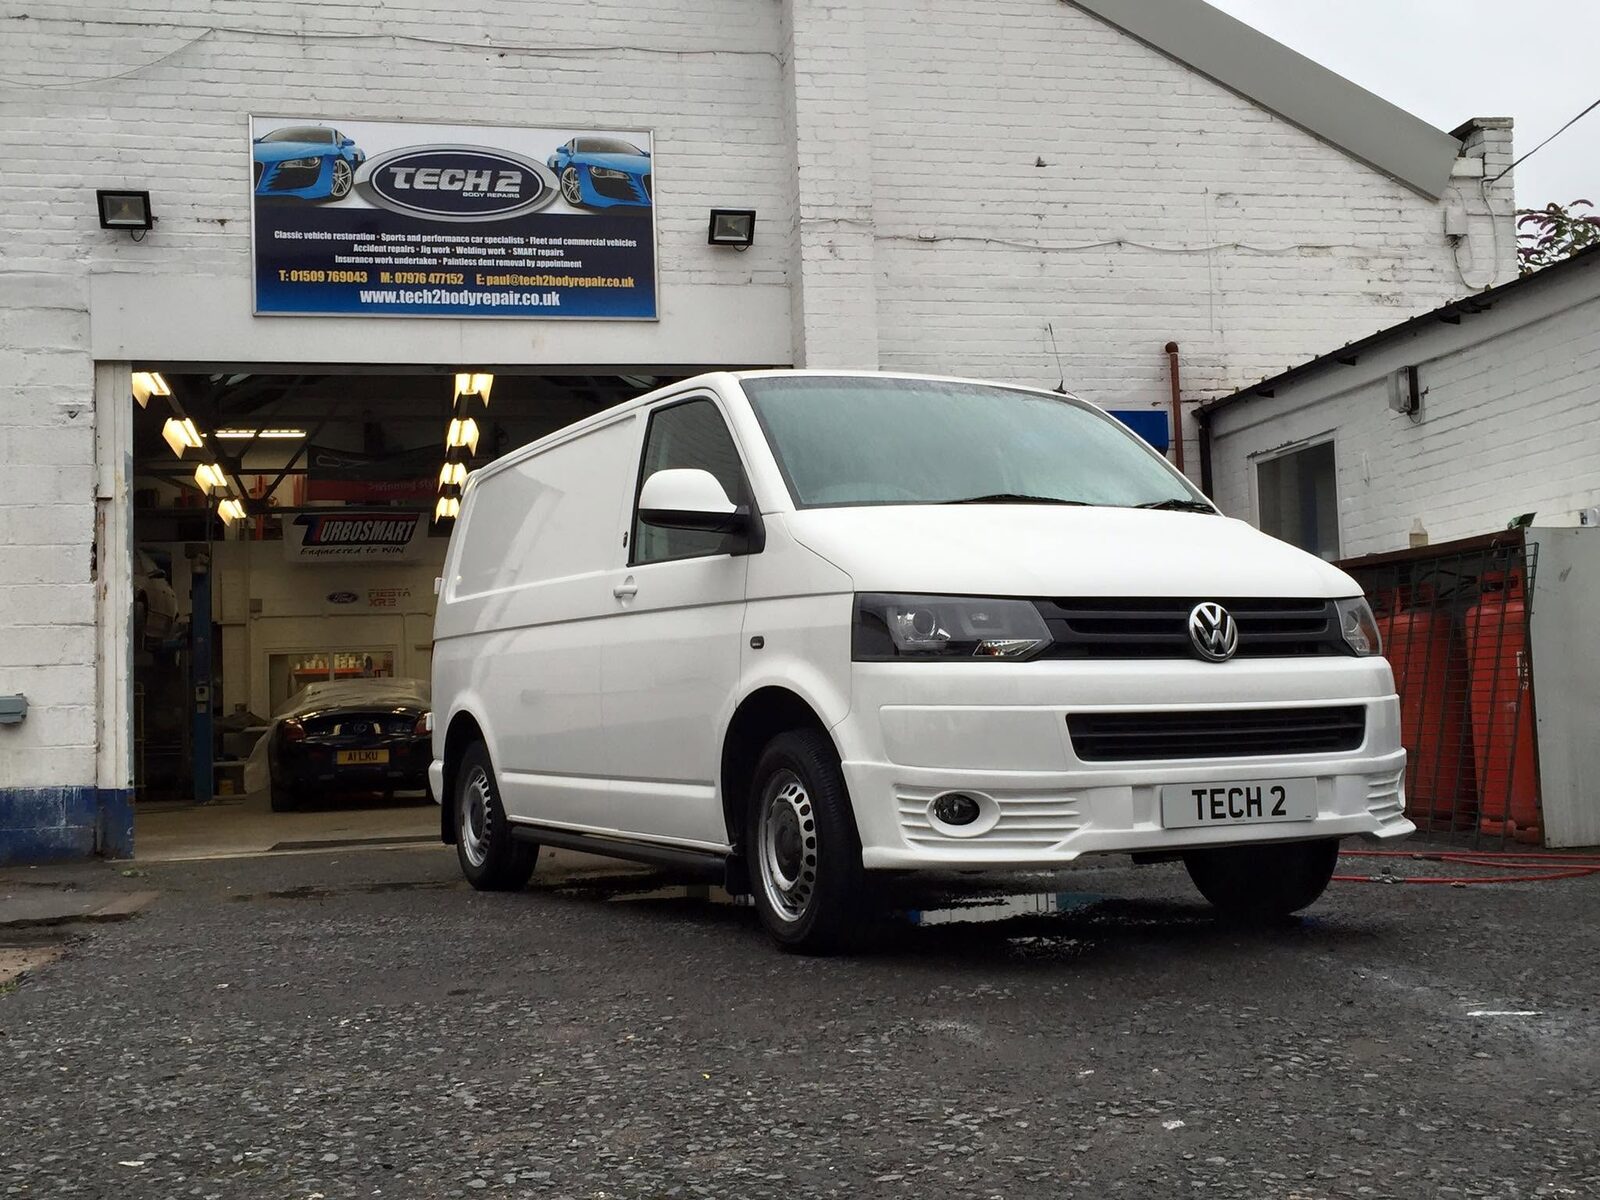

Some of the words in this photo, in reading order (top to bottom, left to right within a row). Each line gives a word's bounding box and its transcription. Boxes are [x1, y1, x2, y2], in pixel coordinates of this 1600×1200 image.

[389, 167, 492, 191] TECH
[494, 170, 523, 192] 2
[274, 230, 303, 239] Classic
[304, 231, 331, 240] vehicle
[333, 232, 375, 241] restoration
[381, 233, 405, 242] Sports
[407, 234, 421, 242] and
[422, 234, 470, 243] performance
[484, 235, 525, 244] specialists
[530, 237, 548, 245] Fleet
[549, 237, 562, 245] and
[563, 238, 606, 247] commercial
[607, 238, 637, 247] vehicles
[354, 244, 386, 252] Accident
[388, 245, 415, 254] repairs
[421, 245, 431, 254] Jig
[432, 246, 450, 254] work
[456, 246, 487, 255] Welding
[488, 247, 505, 255] work
[513, 247, 537, 256] SMART
[538, 248, 564, 257] repairs
[335, 255, 373, 264] Insurance
[375, 256, 393, 264] work
[395, 257, 437, 265] undertaken
[443, 257, 477, 266] Paintless
[478, 258, 495, 266] dent
[496, 258, 525, 267] removal
[526, 259, 536, 268] by
[537, 259, 582, 268] appointment
[279, 270, 289, 281] T:
[291, 270, 325, 282] 01509
[327, 270, 368, 283] 769043
[381, 272, 393, 283] M:
[395, 272, 427, 284] 07976
[428, 273, 464, 285] 477152
[476, 274, 485, 285] E:
[486, 274, 634, 288] paul@tech2bodyrepair.co.uk
[360, 289, 561, 307] www.tech2bodyrepair.co.uk
[293, 513, 420, 546] TURBOSMART
[300, 547, 361, 557] Engineered
[382, 546, 406, 555] WIN
[1192, 787, 1263, 820] TECH
[1270, 785, 1287, 816] 2
